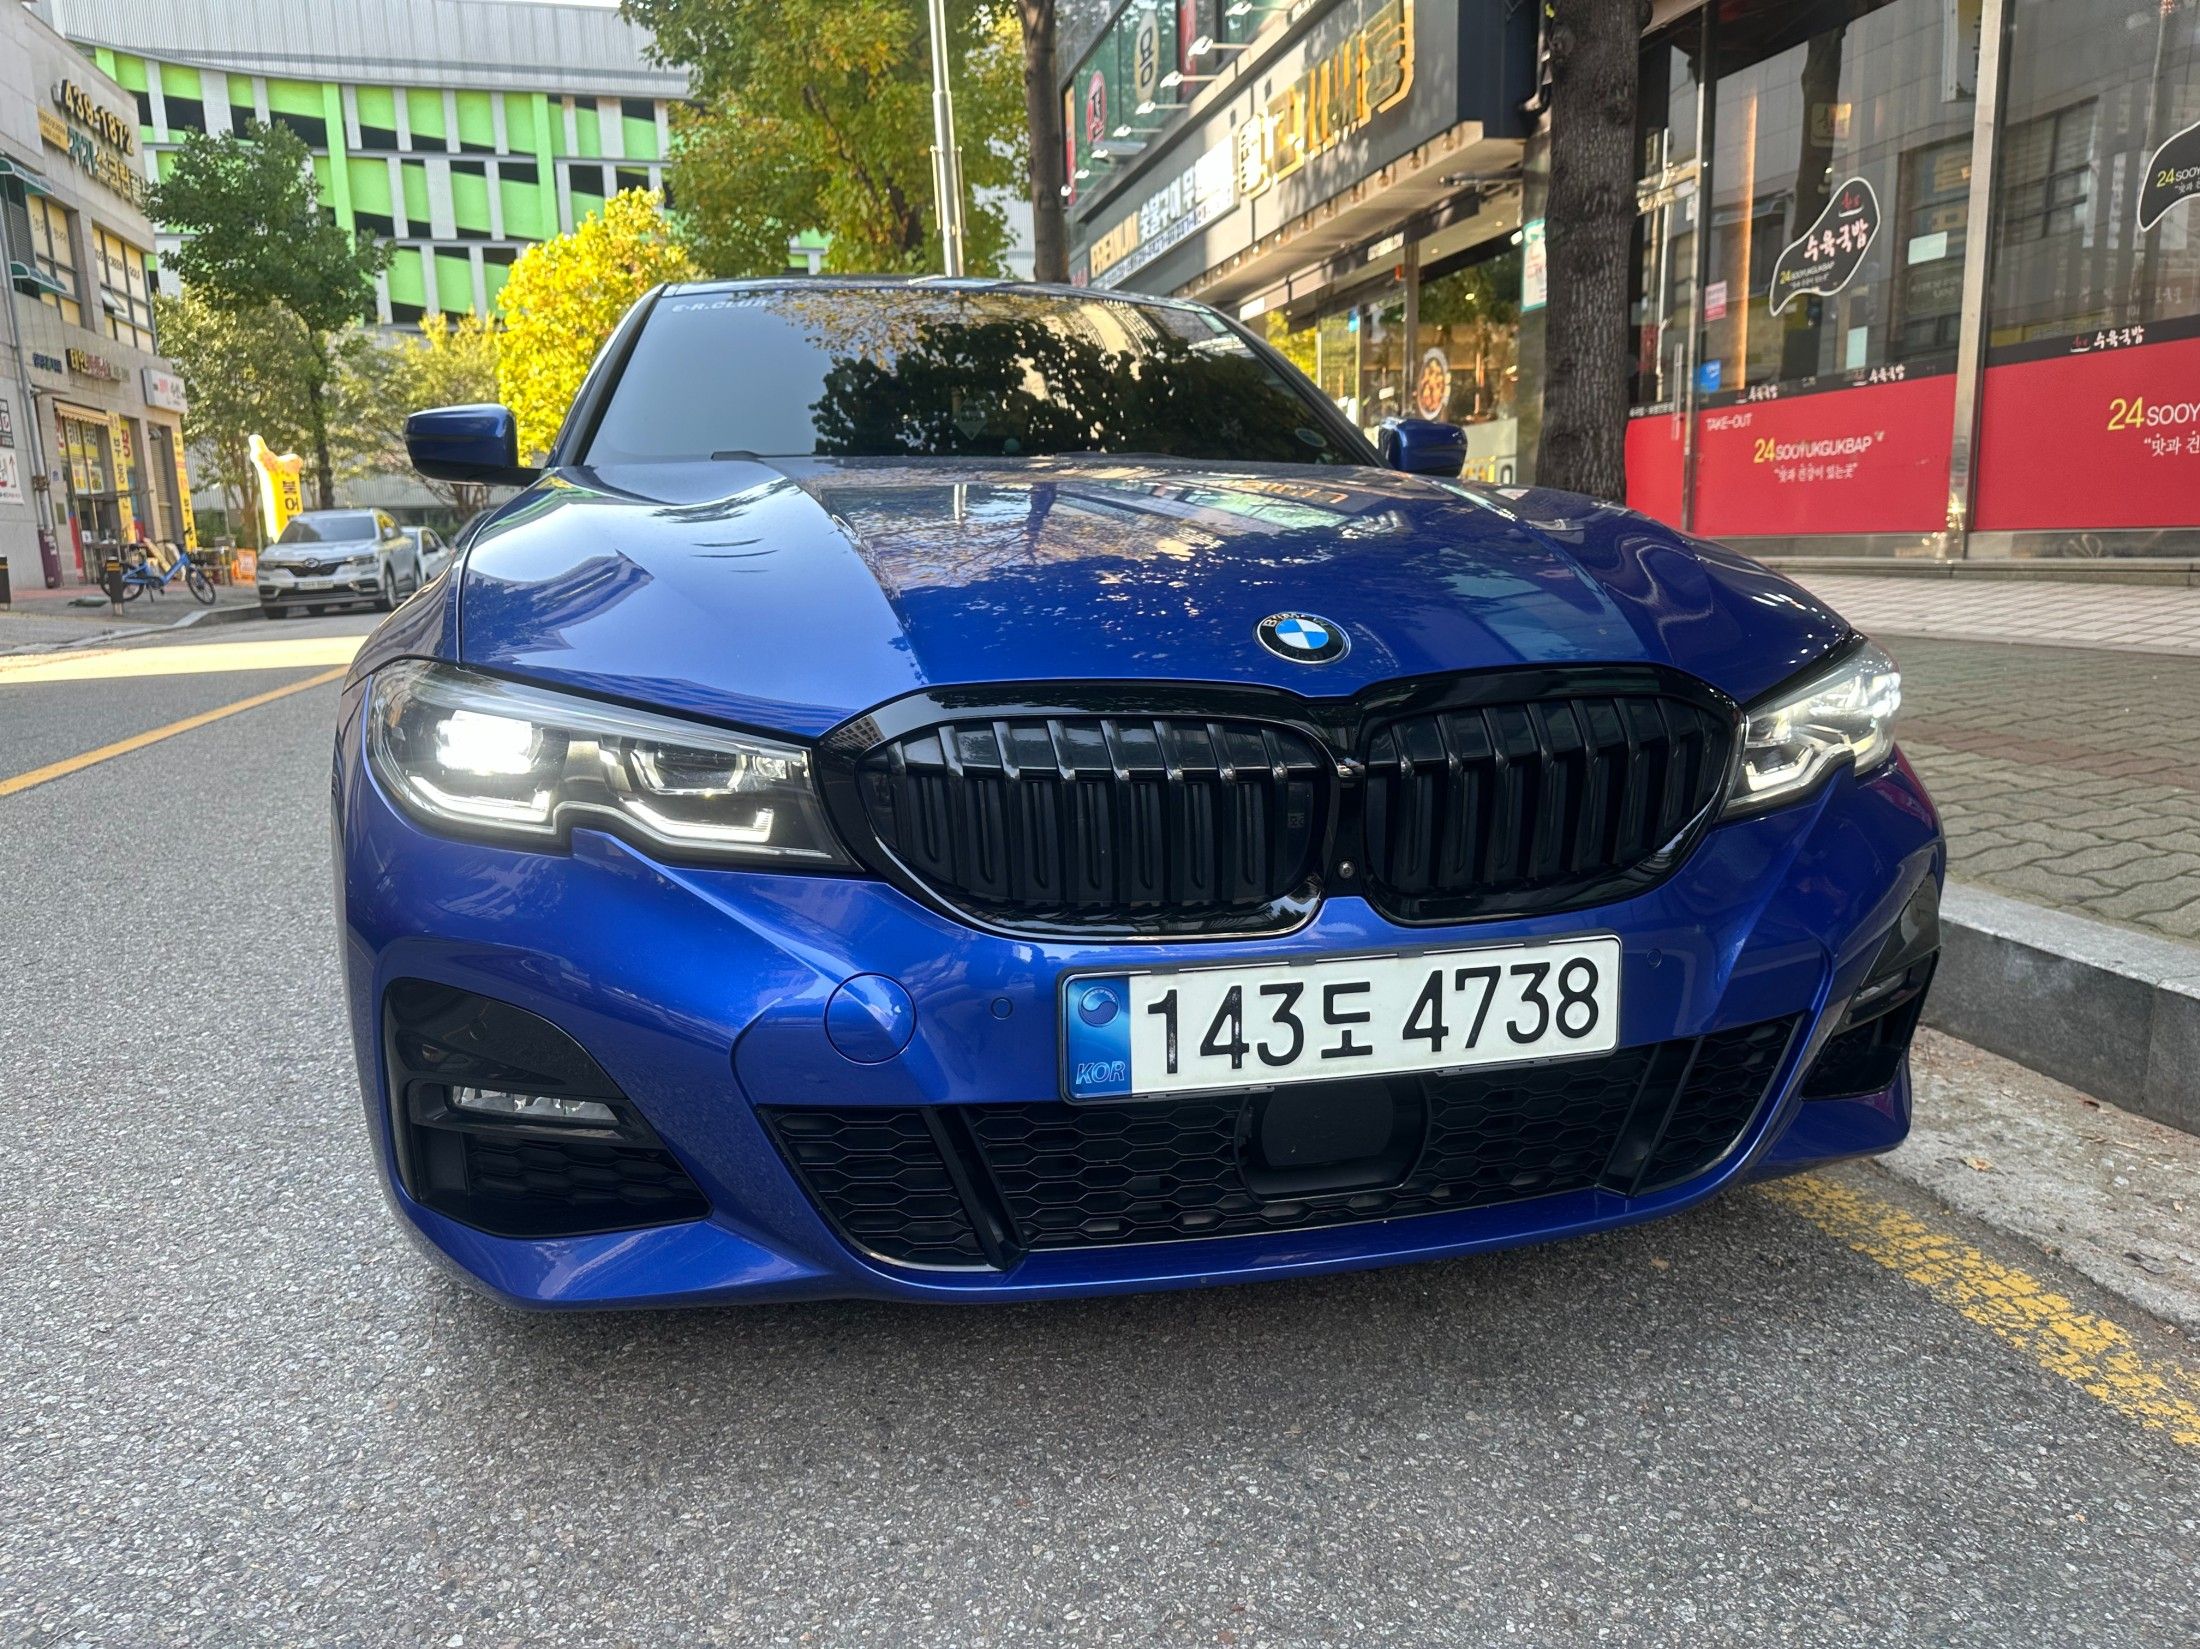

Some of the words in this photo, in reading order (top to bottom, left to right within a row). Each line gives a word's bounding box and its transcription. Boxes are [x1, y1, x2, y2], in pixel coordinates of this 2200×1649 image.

[1803, 217, 1869, 262] 수육국밥
[2093, 324, 2145, 350] 수육국밥
[1705, 411, 1753, 432] TAKE-OUT
[1147, 981, 1373, 1074] 143도
[1402, 957, 1599, 1052] 4738
[1075, 1061, 1126, 1085] KOR
